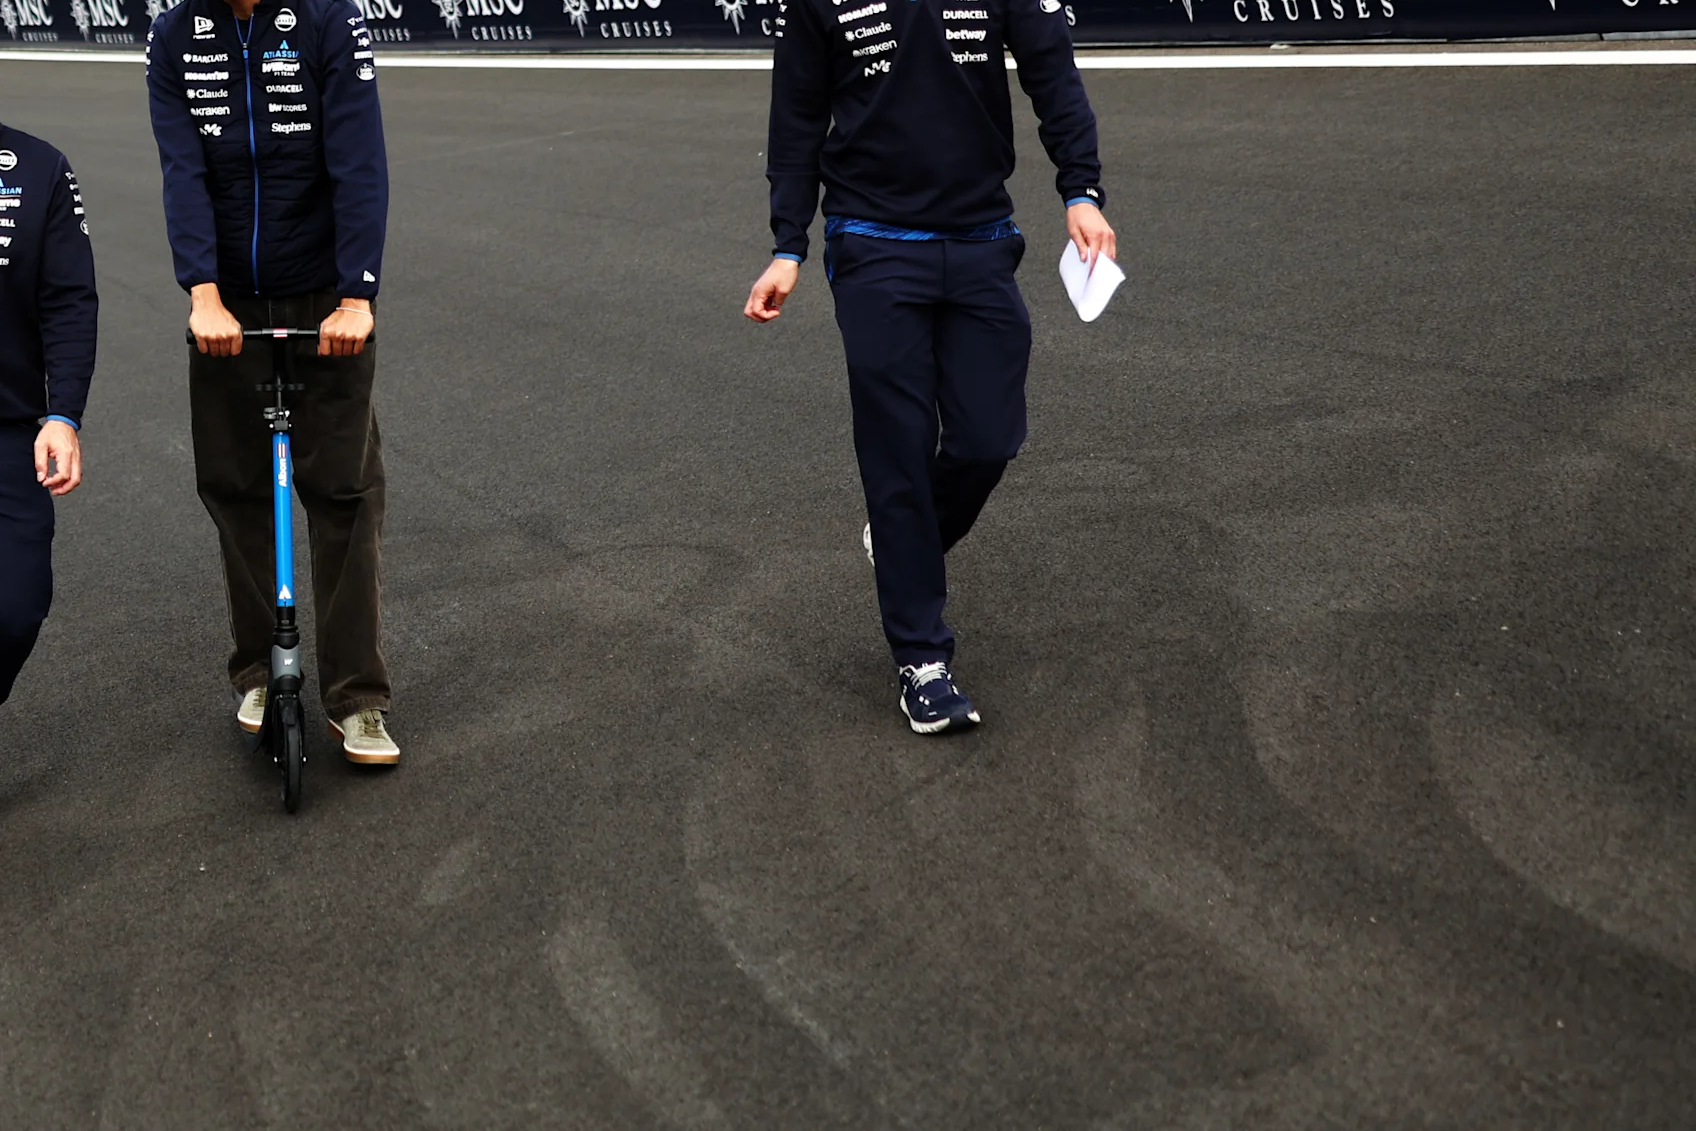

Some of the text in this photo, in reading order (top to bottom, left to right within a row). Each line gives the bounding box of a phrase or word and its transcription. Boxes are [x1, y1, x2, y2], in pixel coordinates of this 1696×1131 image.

[942, 10, 989, 20] DURACELL
[367, 27, 410, 41] UISES
[471, 24, 532, 41] CRUISES
[600, 20, 672, 38] CRUISES
[854, 22, 892, 39] Claude
[945, 28, 987, 41] betway
[859, 39, 897, 56] kraken
[192, 53, 229, 63] BARCLAYS
[195, 88, 228, 99] Claude
[195, 106, 230, 116] kraken
[271, 121, 312, 134] Stephens
[278, 459, 286, 487] Albon
